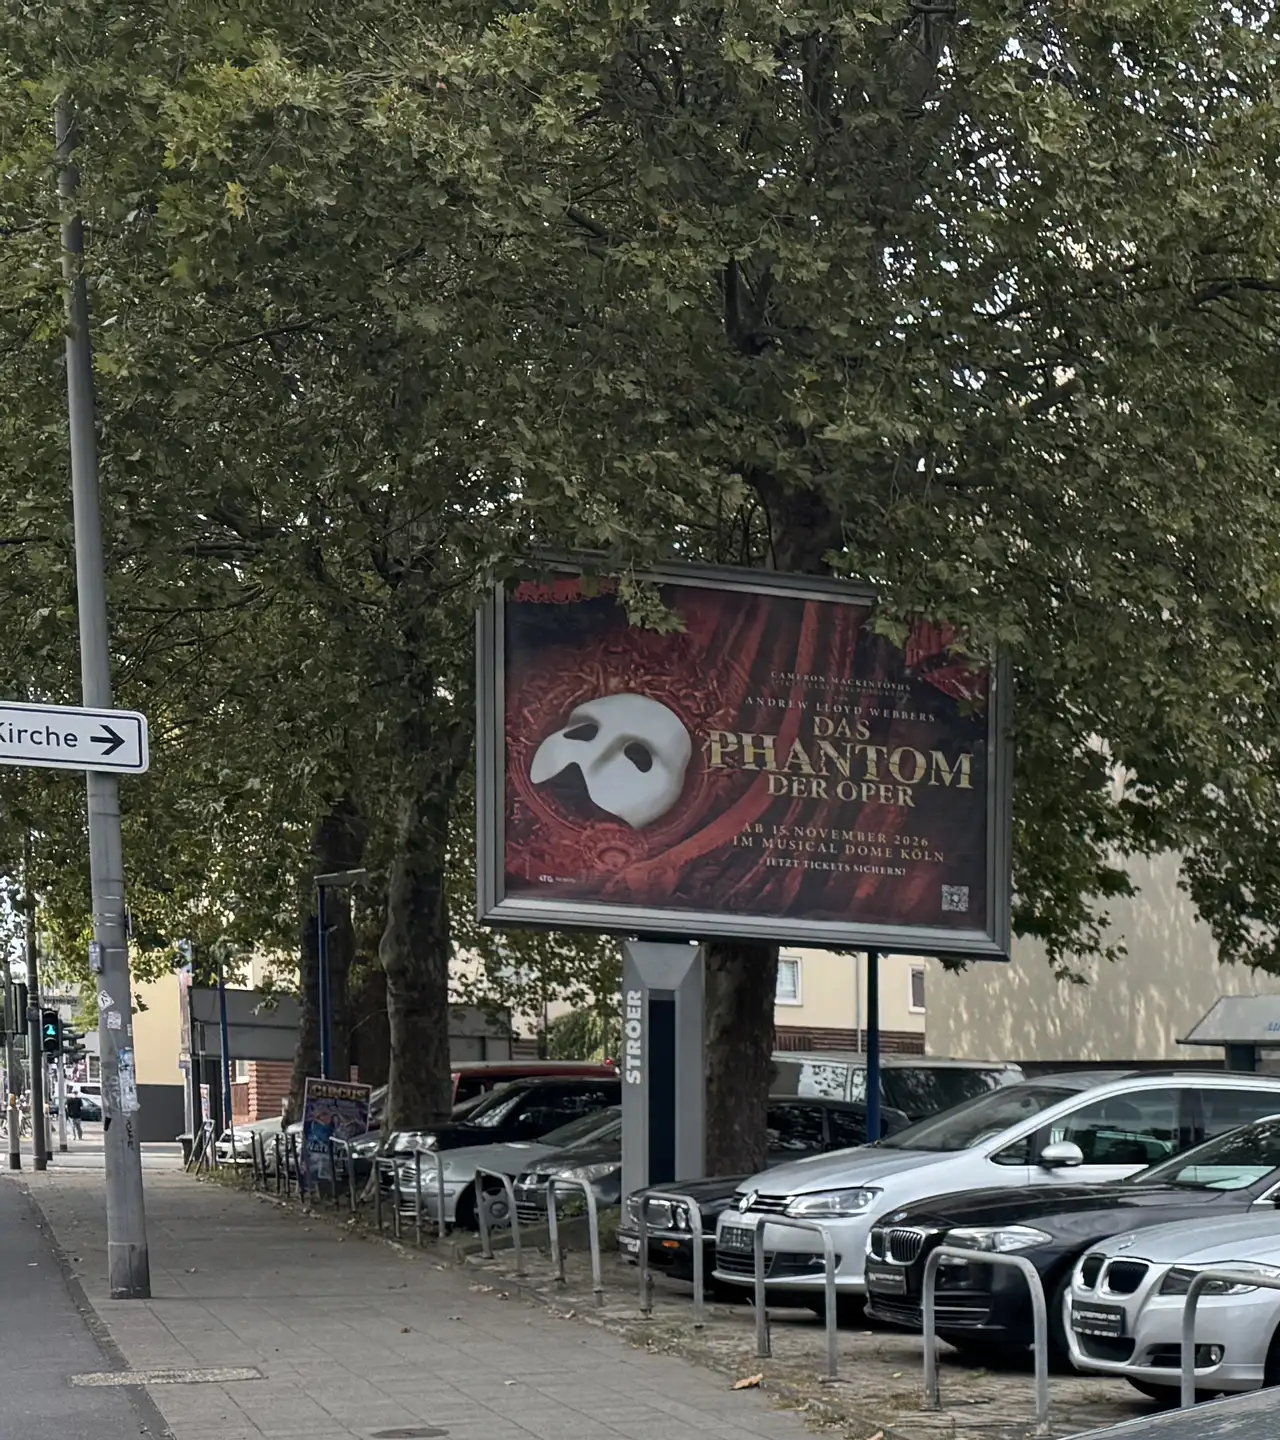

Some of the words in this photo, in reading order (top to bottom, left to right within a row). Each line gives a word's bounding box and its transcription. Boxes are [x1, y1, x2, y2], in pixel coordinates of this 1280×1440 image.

[770, 671, 825, 683] CAMERON
[745, 696, 808, 710] ANDREW
[816, 702, 863, 715] LLOYD
[869, 708, 936, 723] WEBBERS
[813, 716, 871, 740] DAS
[707, 729, 975, 789] PHANTOM
[767, 774, 829, 801] DER
[836, 779, 916, 807] OPER
[733, 835, 753, 848] IM
[762, 837, 838, 855] MUSICAL
[845, 845, 892, 859] DOME
[900, 847, 945, 862] KÖLN
[741, 822, 763, 834] AB
[794, 826, 887, 845] NOVEMBER
[894, 836, 929, 848] 2026
[766, 857, 799, 869] JETZT
[804, 859, 851, 873] TICKETS
[625, 990, 642, 1085] STRÖER
